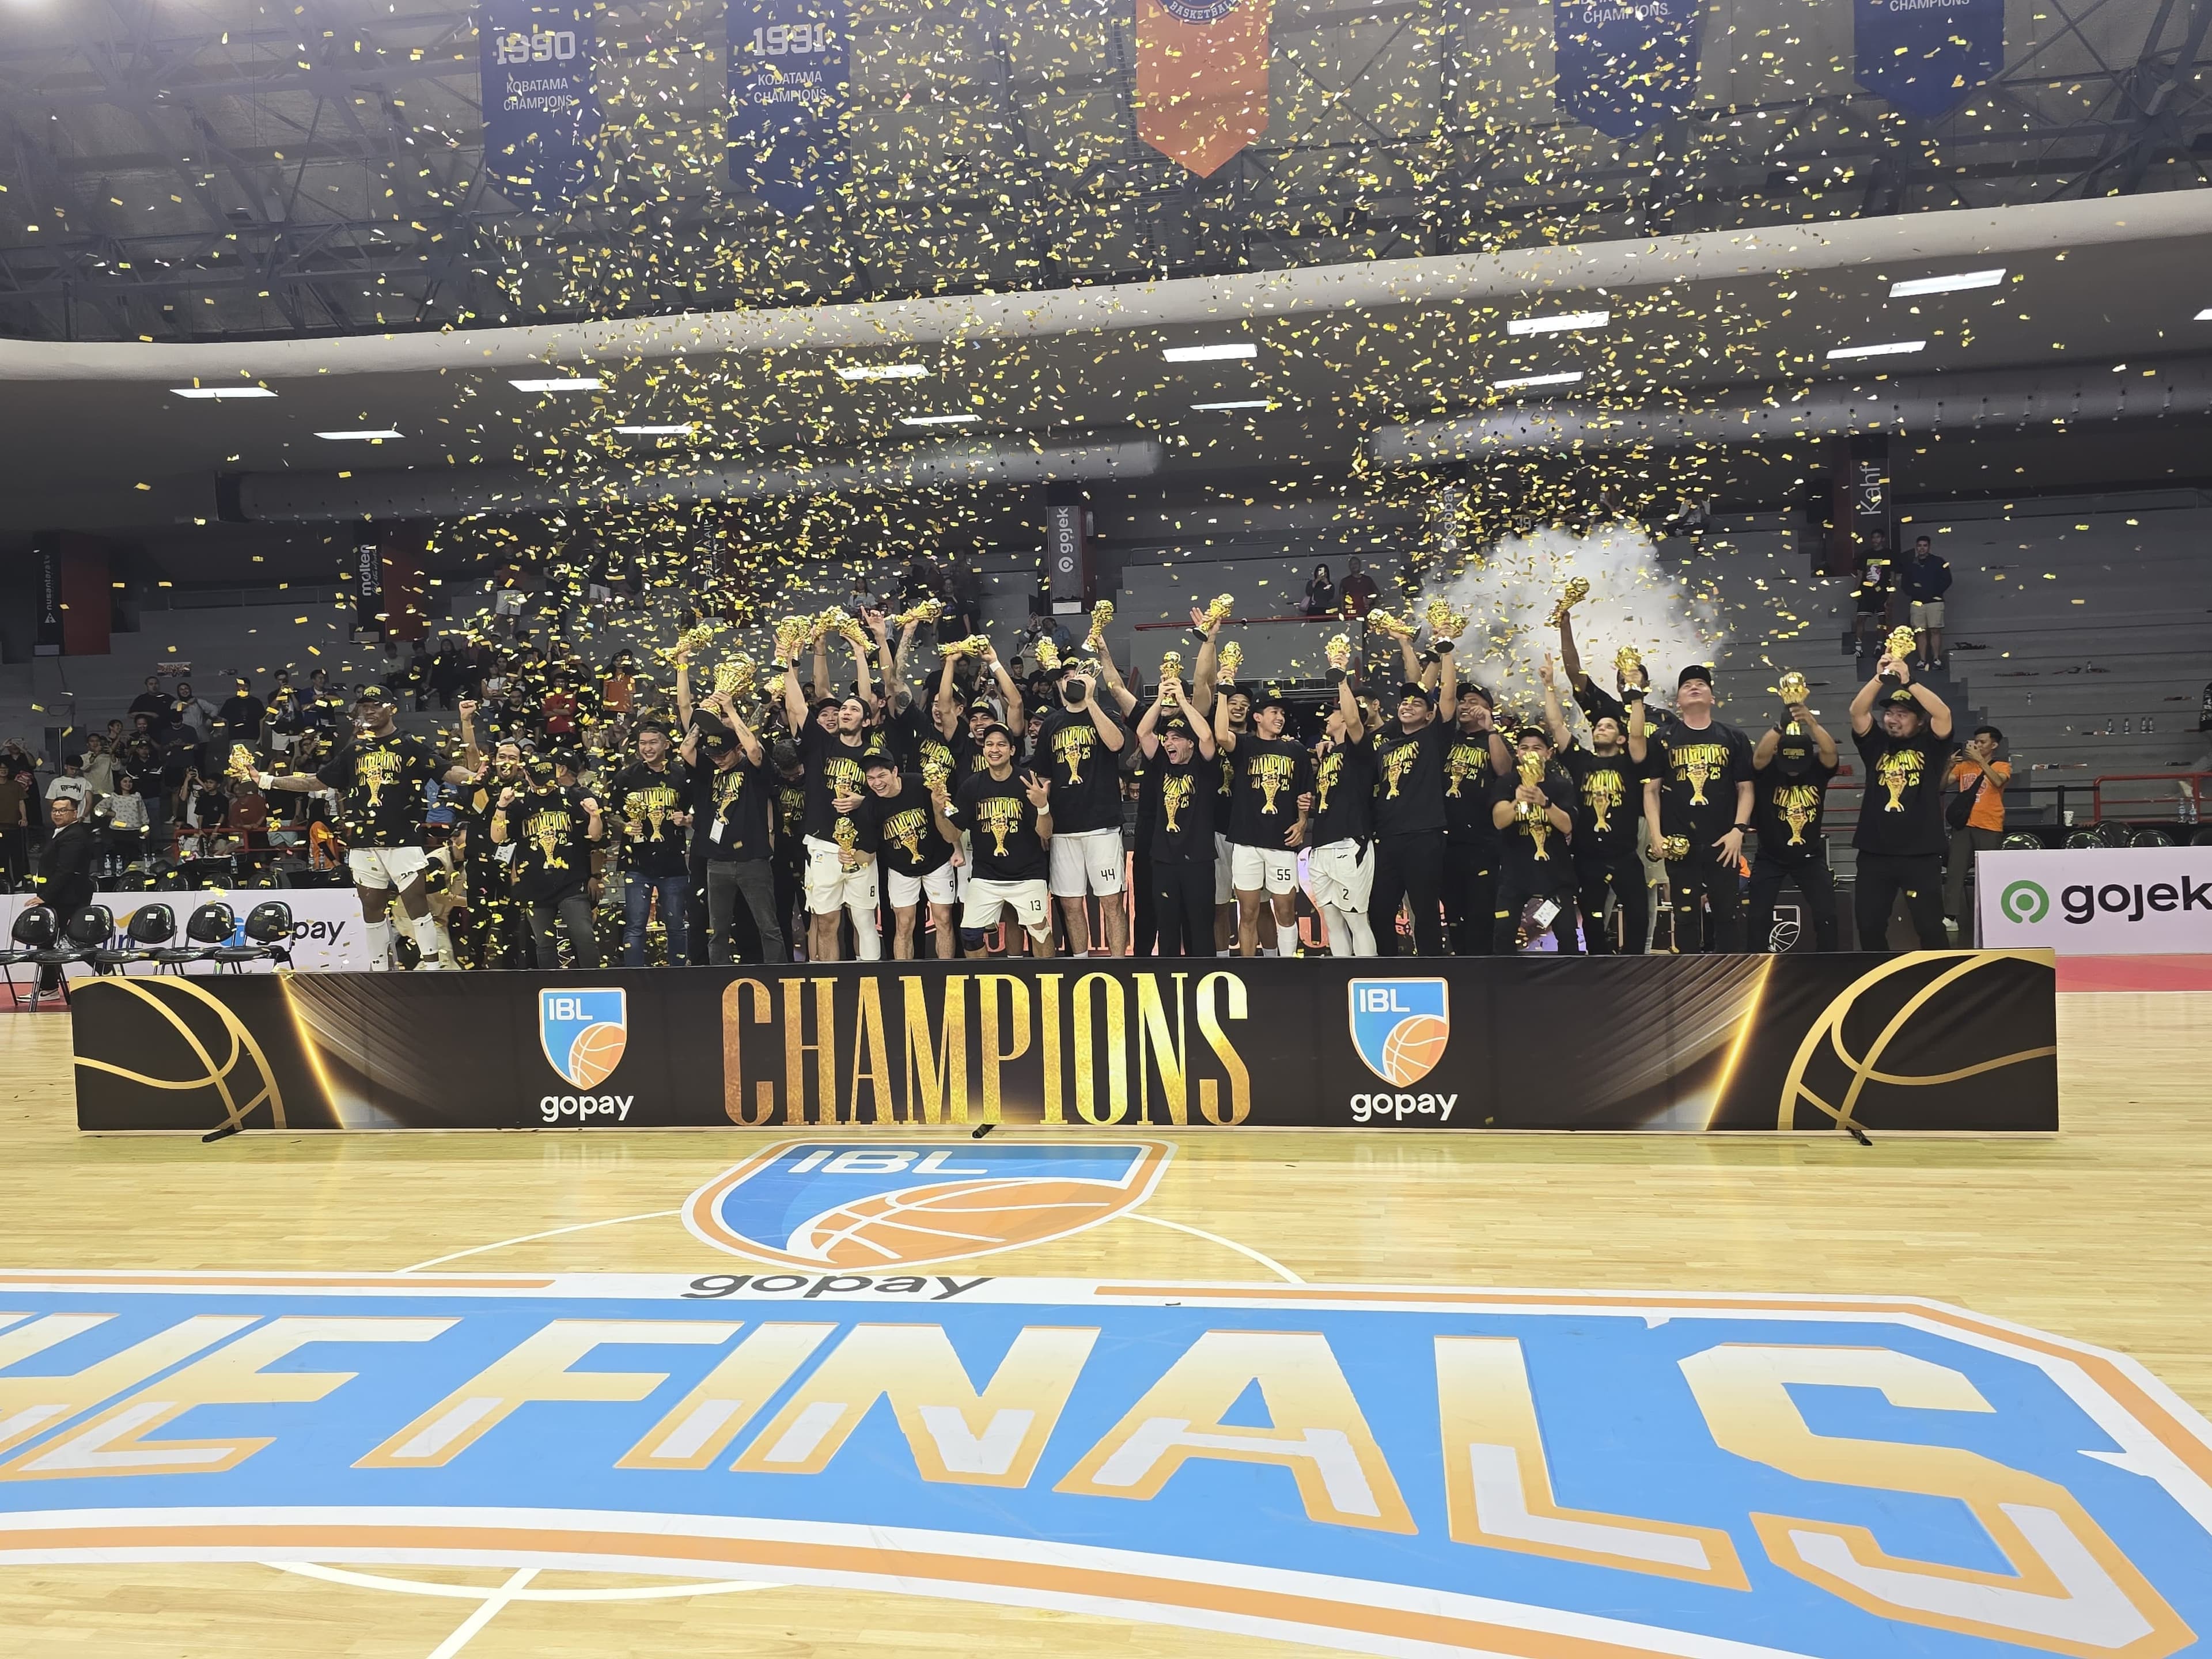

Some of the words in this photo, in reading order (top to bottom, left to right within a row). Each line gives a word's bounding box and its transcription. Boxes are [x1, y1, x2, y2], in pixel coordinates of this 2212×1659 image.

[496, 31, 576, 65] 1990
[753, 23, 826, 56] 1991
[506, 78, 569, 93] KOBATAMA
[503, 94, 573, 111] CHAMPIONS
[1859, 465, 1881, 515] Kahf
[1056, 507, 1074, 554] gojek
[359, 544, 372, 596] molten
[1051, 727, 1097, 753] CHAMPIONS
[1082, 746, 1090, 760] 25
[1668, 747, 1730, 769] CHAMPIONS
[824, 756, 867, 785] CHAMPION
[1710, 767, 1721, 780] 25
[976, 800, 1024, 821] CHAMPIONS
[982, 820, 991, 833] 20
[1009, 820, 1018, 833] 25
[949, 880, 955, 892] 9
[1101, 869, 1115, 881] 44
[1277, 869, 1290, 881] 55
[869, 885, 875, 897] 8
[1343, 888, 1349, 900] 2
[2061, 876, 2212, 924] gojek
[1030, 900, 1041, 911] 13
[257, 920, 346, 946] pay
[548, 998, 593, 1021] IBL
[1359, 988, 1410, 1013] IBL
[721, 971, 1251, 1127] CHAMPIONS
[540, 1095, 634, 1122] gopay
[1350, 1093, 1458, 1122] gopay
[787, 1149, 988, 1174] IBL
[680, 1275, 997, 1300] gopay
[0, 1311, 466, 1482] HE
[349, 1318, 2199, 1659] FINALS
